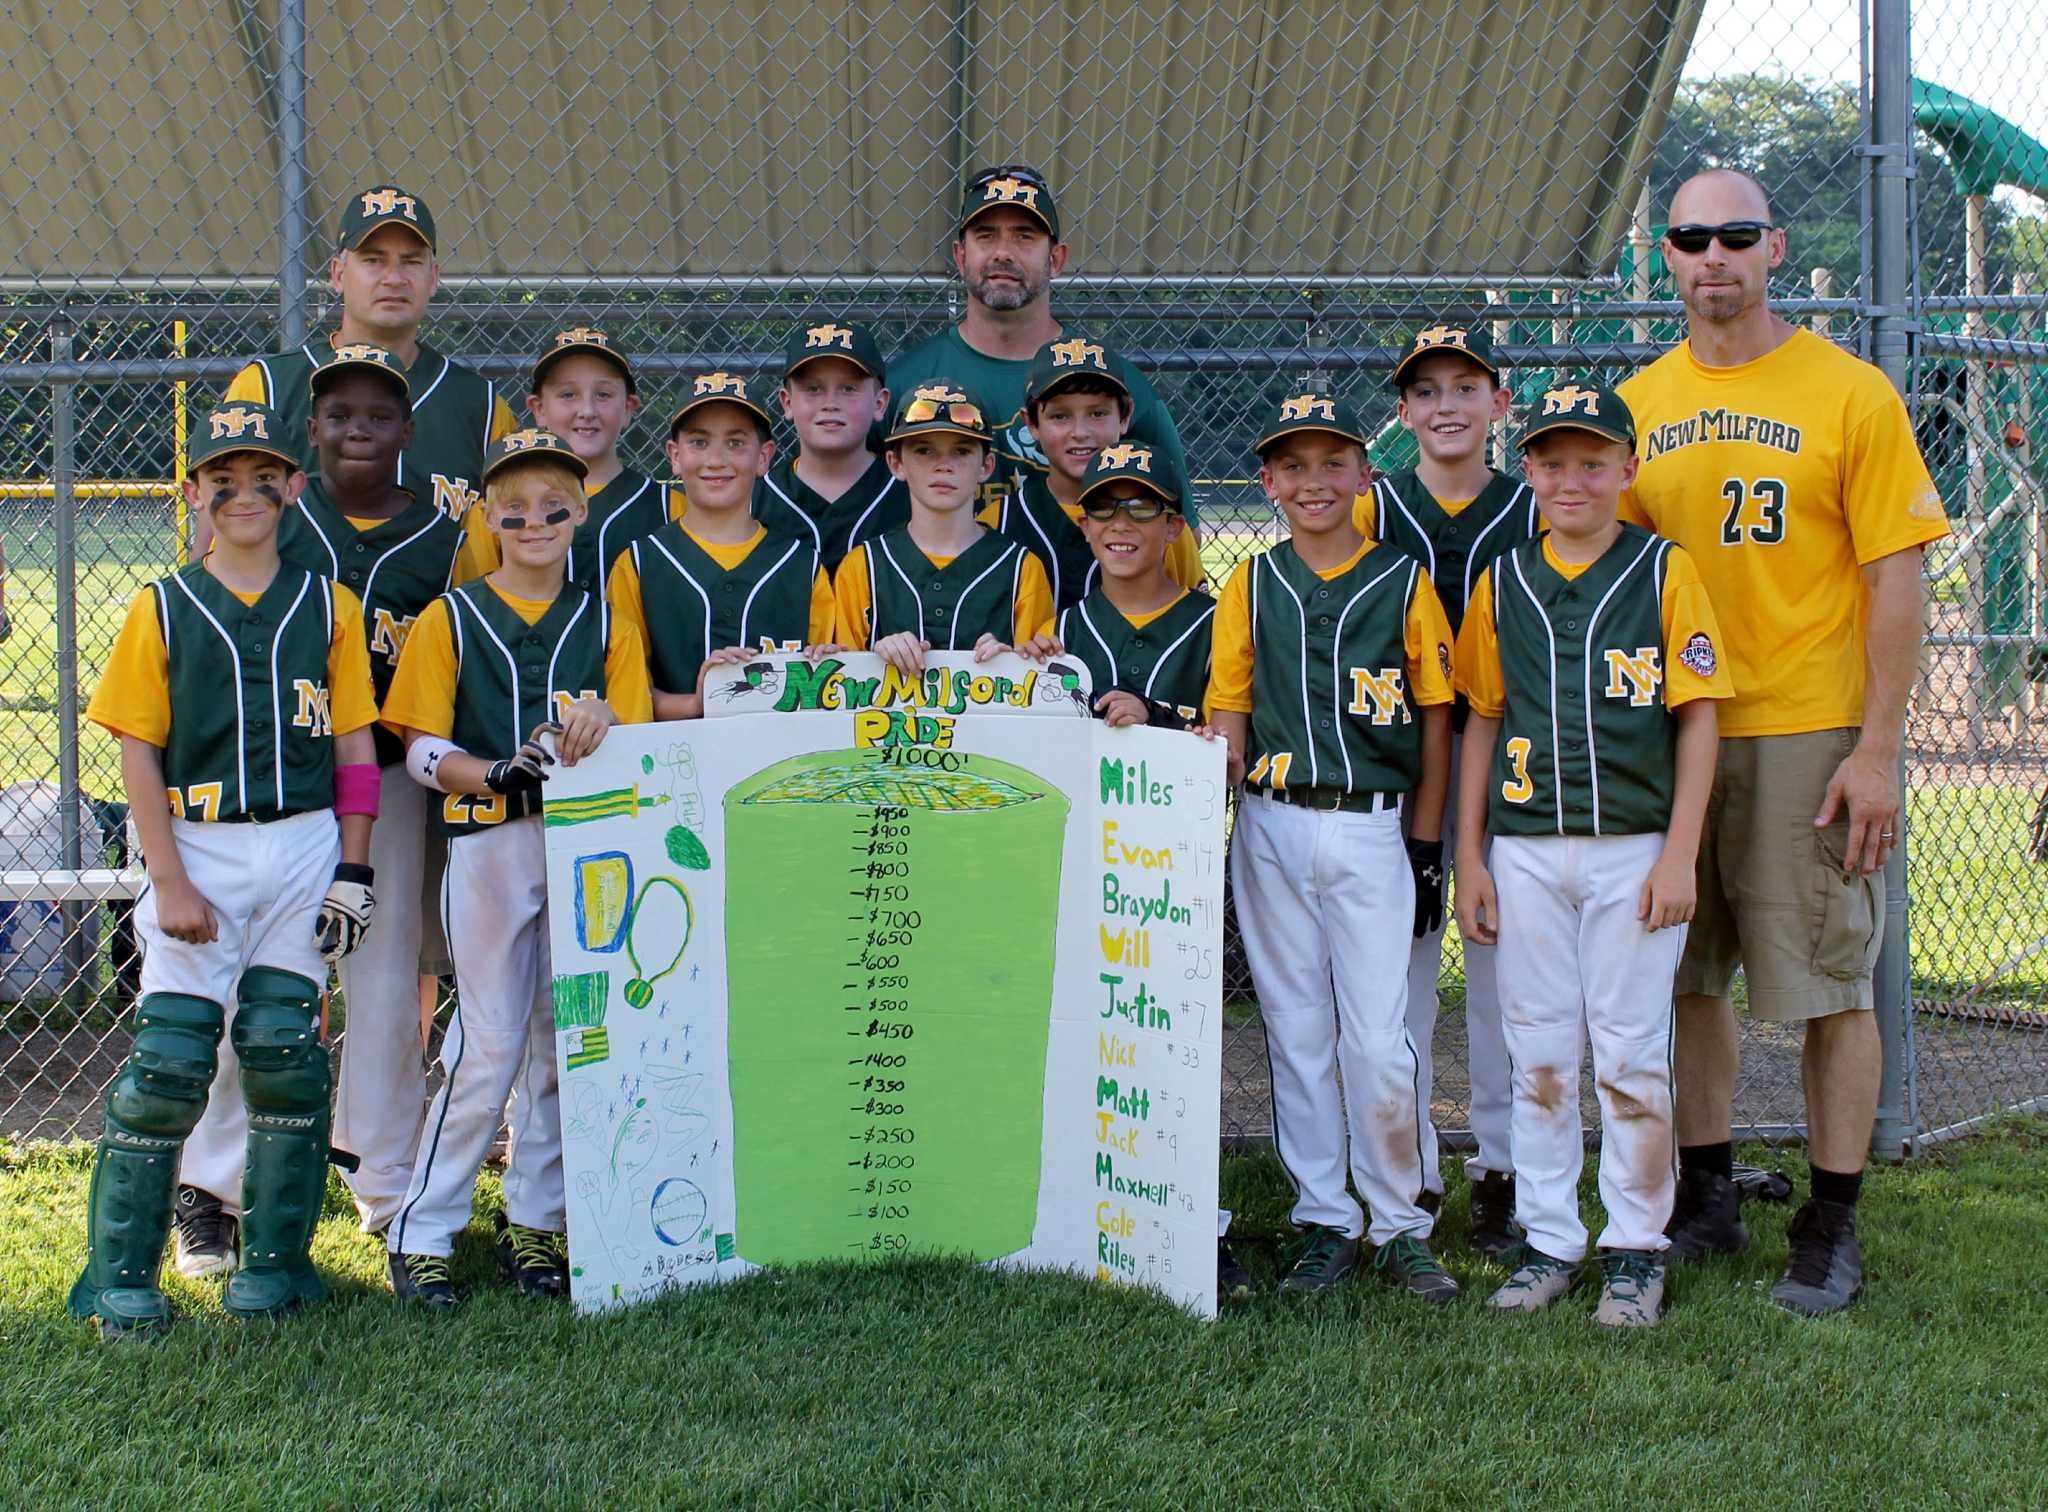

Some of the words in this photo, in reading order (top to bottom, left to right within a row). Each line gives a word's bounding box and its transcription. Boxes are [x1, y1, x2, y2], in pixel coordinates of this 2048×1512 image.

[1645, 418, 1697, 464] NEW
[1698, 407, 1801, 456] MILFORD
[1721, 477, 1789, 546] 23
[772, 658, 881, 713] New
[872, 663, 1038, 715] Milford
[1100, 756, 1174, 806] Miles
[1502, 737, 1534, 804] 3
[873, 804, 909, 823] $950
[868, 823, 911, 838] $900
[867, 841, 908, 856] $850
[1103, 820, 1173, 871] Evan
[866, 861, 909, 879] $800
[865, 884, 909, 902] $750
[1103, 872, 1191, 926] Braydon
[869, 908, 921, 929] $700
[866, 929, 913, 947] $650
[1100, 922, 1150, 969] Will
[861, 948, 899, 970] $600
[867, 975, 909, 991] $550
[868, 998, 908, 1012] $500
[1099, 972, 1171, 1031] Justin
[865, 1018, 914, 1040] $450
[1099, 1031, 1137, 1068] Nick
[864, 1075, 905, 1092] $350
[865, 1097, 904, 1115] $300
[1097, 1075, 1150, 1120] Matt
[864, 1126, 914, 1144] $250
[863, 1152, 915, 1169] $200
[865, 1178, 912, 1196] $150
[868, 1203, 910, 1219] $100
[1096, 1200, 1137, 1238] Cole
[869, 1232, 907, 1250] $50
[1098, 1231, 1135, 1276] Riley
